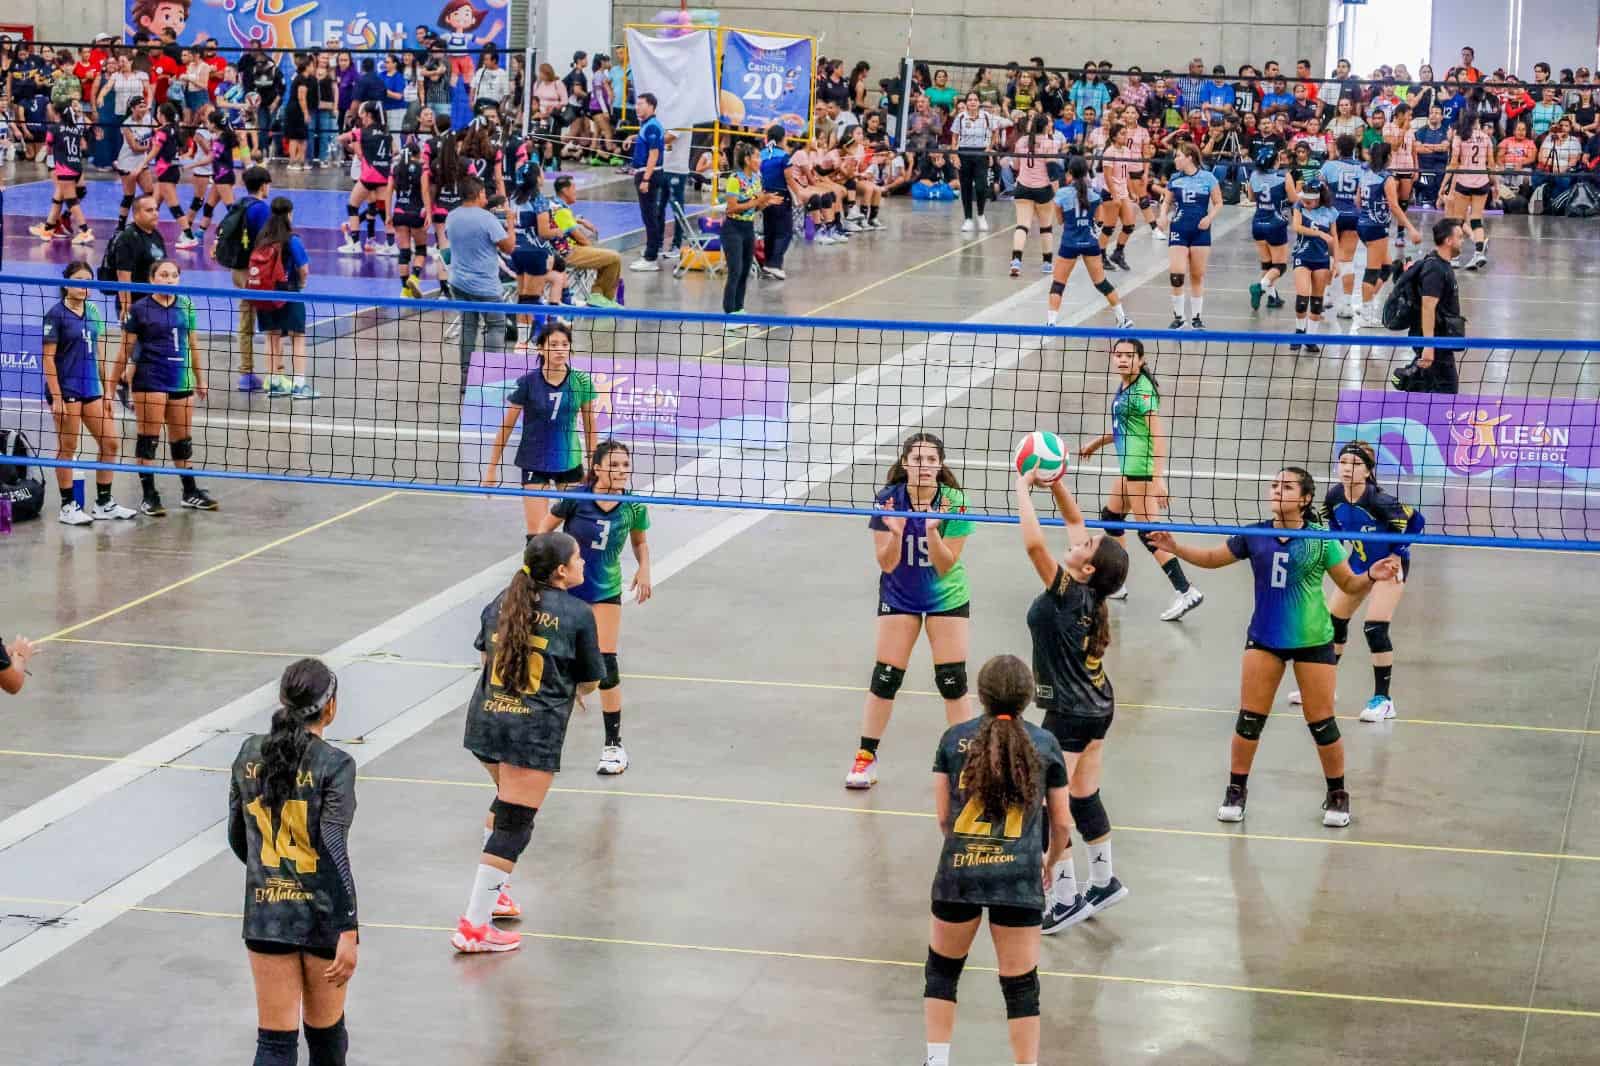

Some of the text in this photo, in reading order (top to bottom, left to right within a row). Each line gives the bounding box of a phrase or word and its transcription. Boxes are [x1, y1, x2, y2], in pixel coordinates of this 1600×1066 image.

[747, 62, 785, 73] Cancha
[743, 72, 783, 100] 20
[64, 136, 78, 156] 16
[377, 139, 386, 159] 4
[1471, 145, 1480, 164] 2
[1259, 183, 1271, 202] 3
[1338, 169, 1356, 193] 15
[1182, 188, 1197, 203] 12
[82, 329, 93, 353] 4
[172, 327, 179, 352] 1
[549, 391, 563, 420] 7
[615, 384, 681, 408] LEÓN
[1500, 421, 1569, 446] LEÓN
[1500, 451, 1567, 462] VOLEIBOL
[591, 519, 611, 551] 3
[1271, 551, 1290, 588] 6
[246, 795, 320, 873] 14
